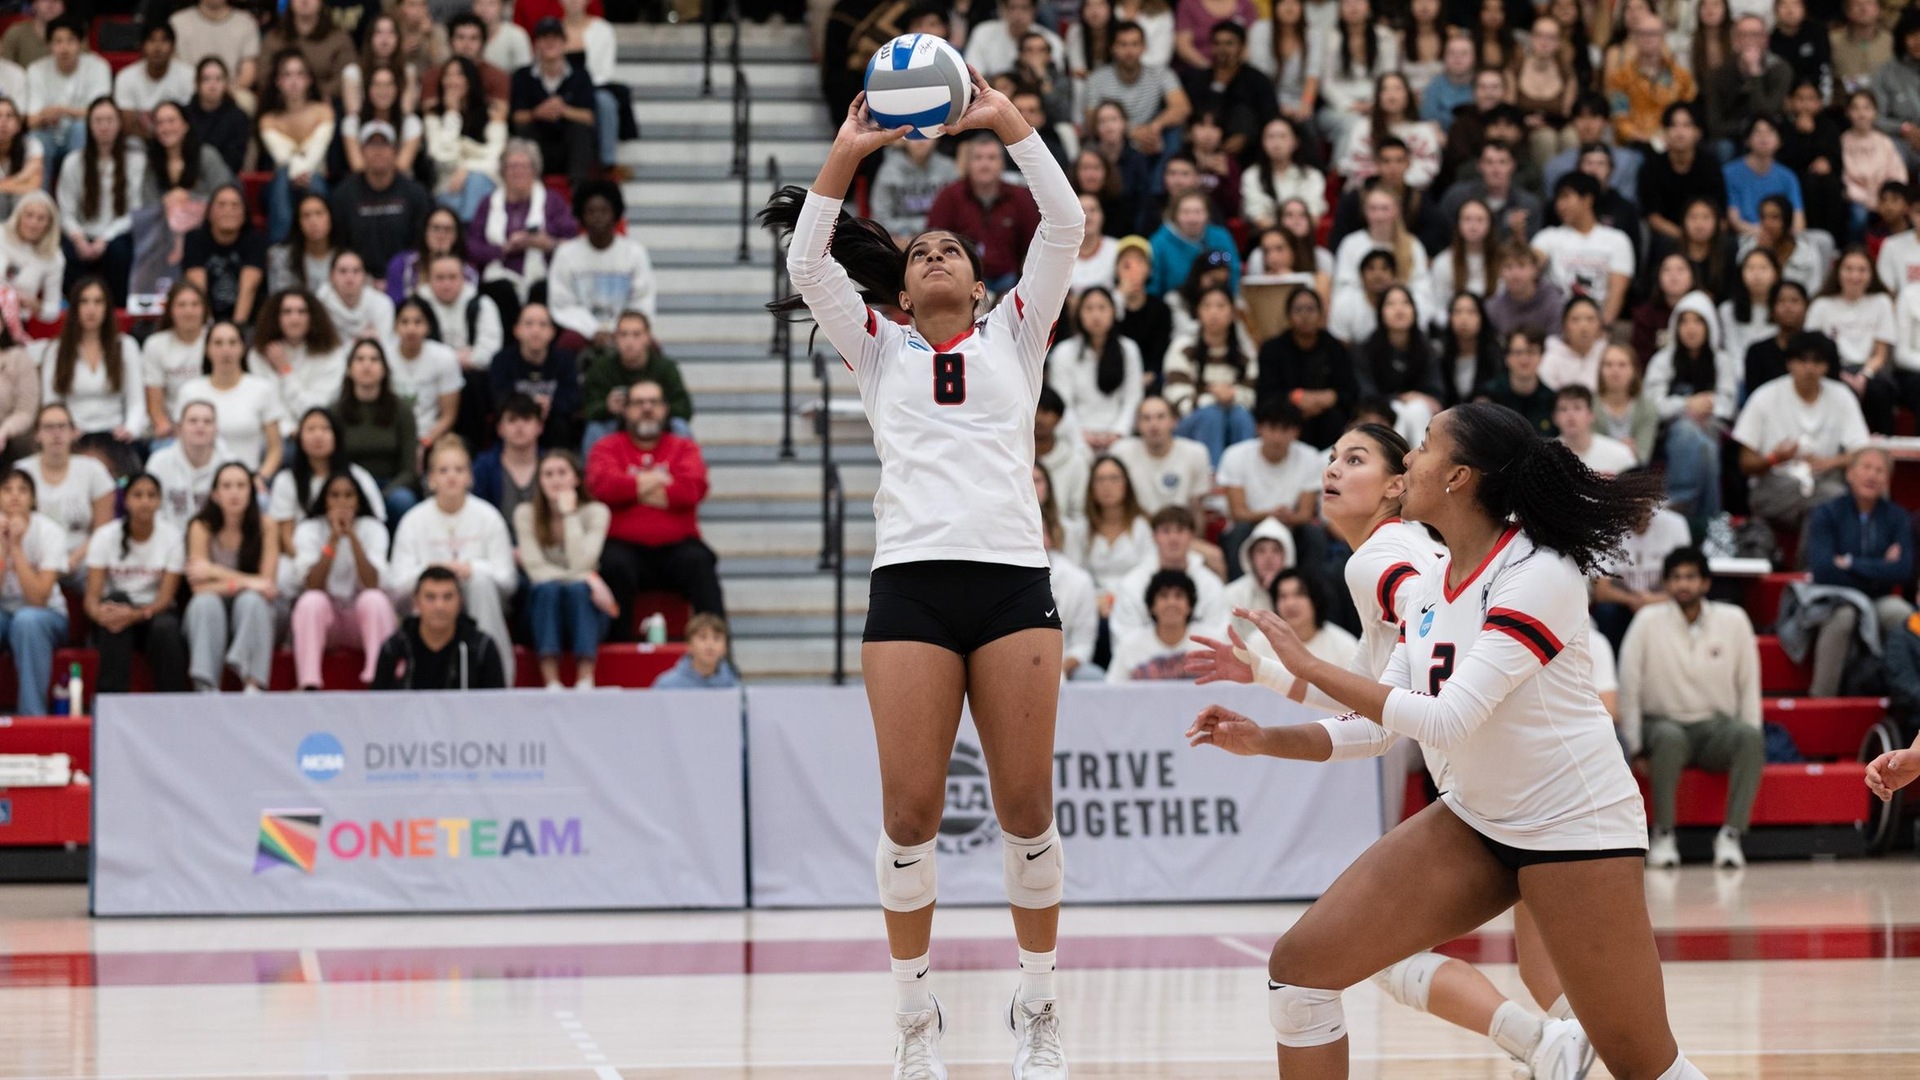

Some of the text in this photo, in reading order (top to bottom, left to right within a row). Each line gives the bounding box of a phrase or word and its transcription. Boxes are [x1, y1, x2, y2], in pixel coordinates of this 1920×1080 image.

[933, 352, 966, 405] 8
[1429, 643, 1456, 698] 2
[364, 741, 546, 769] DIVISION III
[1054, 751, 1175, 790] TRIVE
[328, 816, 582, 861] ONETEAM
[1056, 799, 1239, 838] OGETHER
